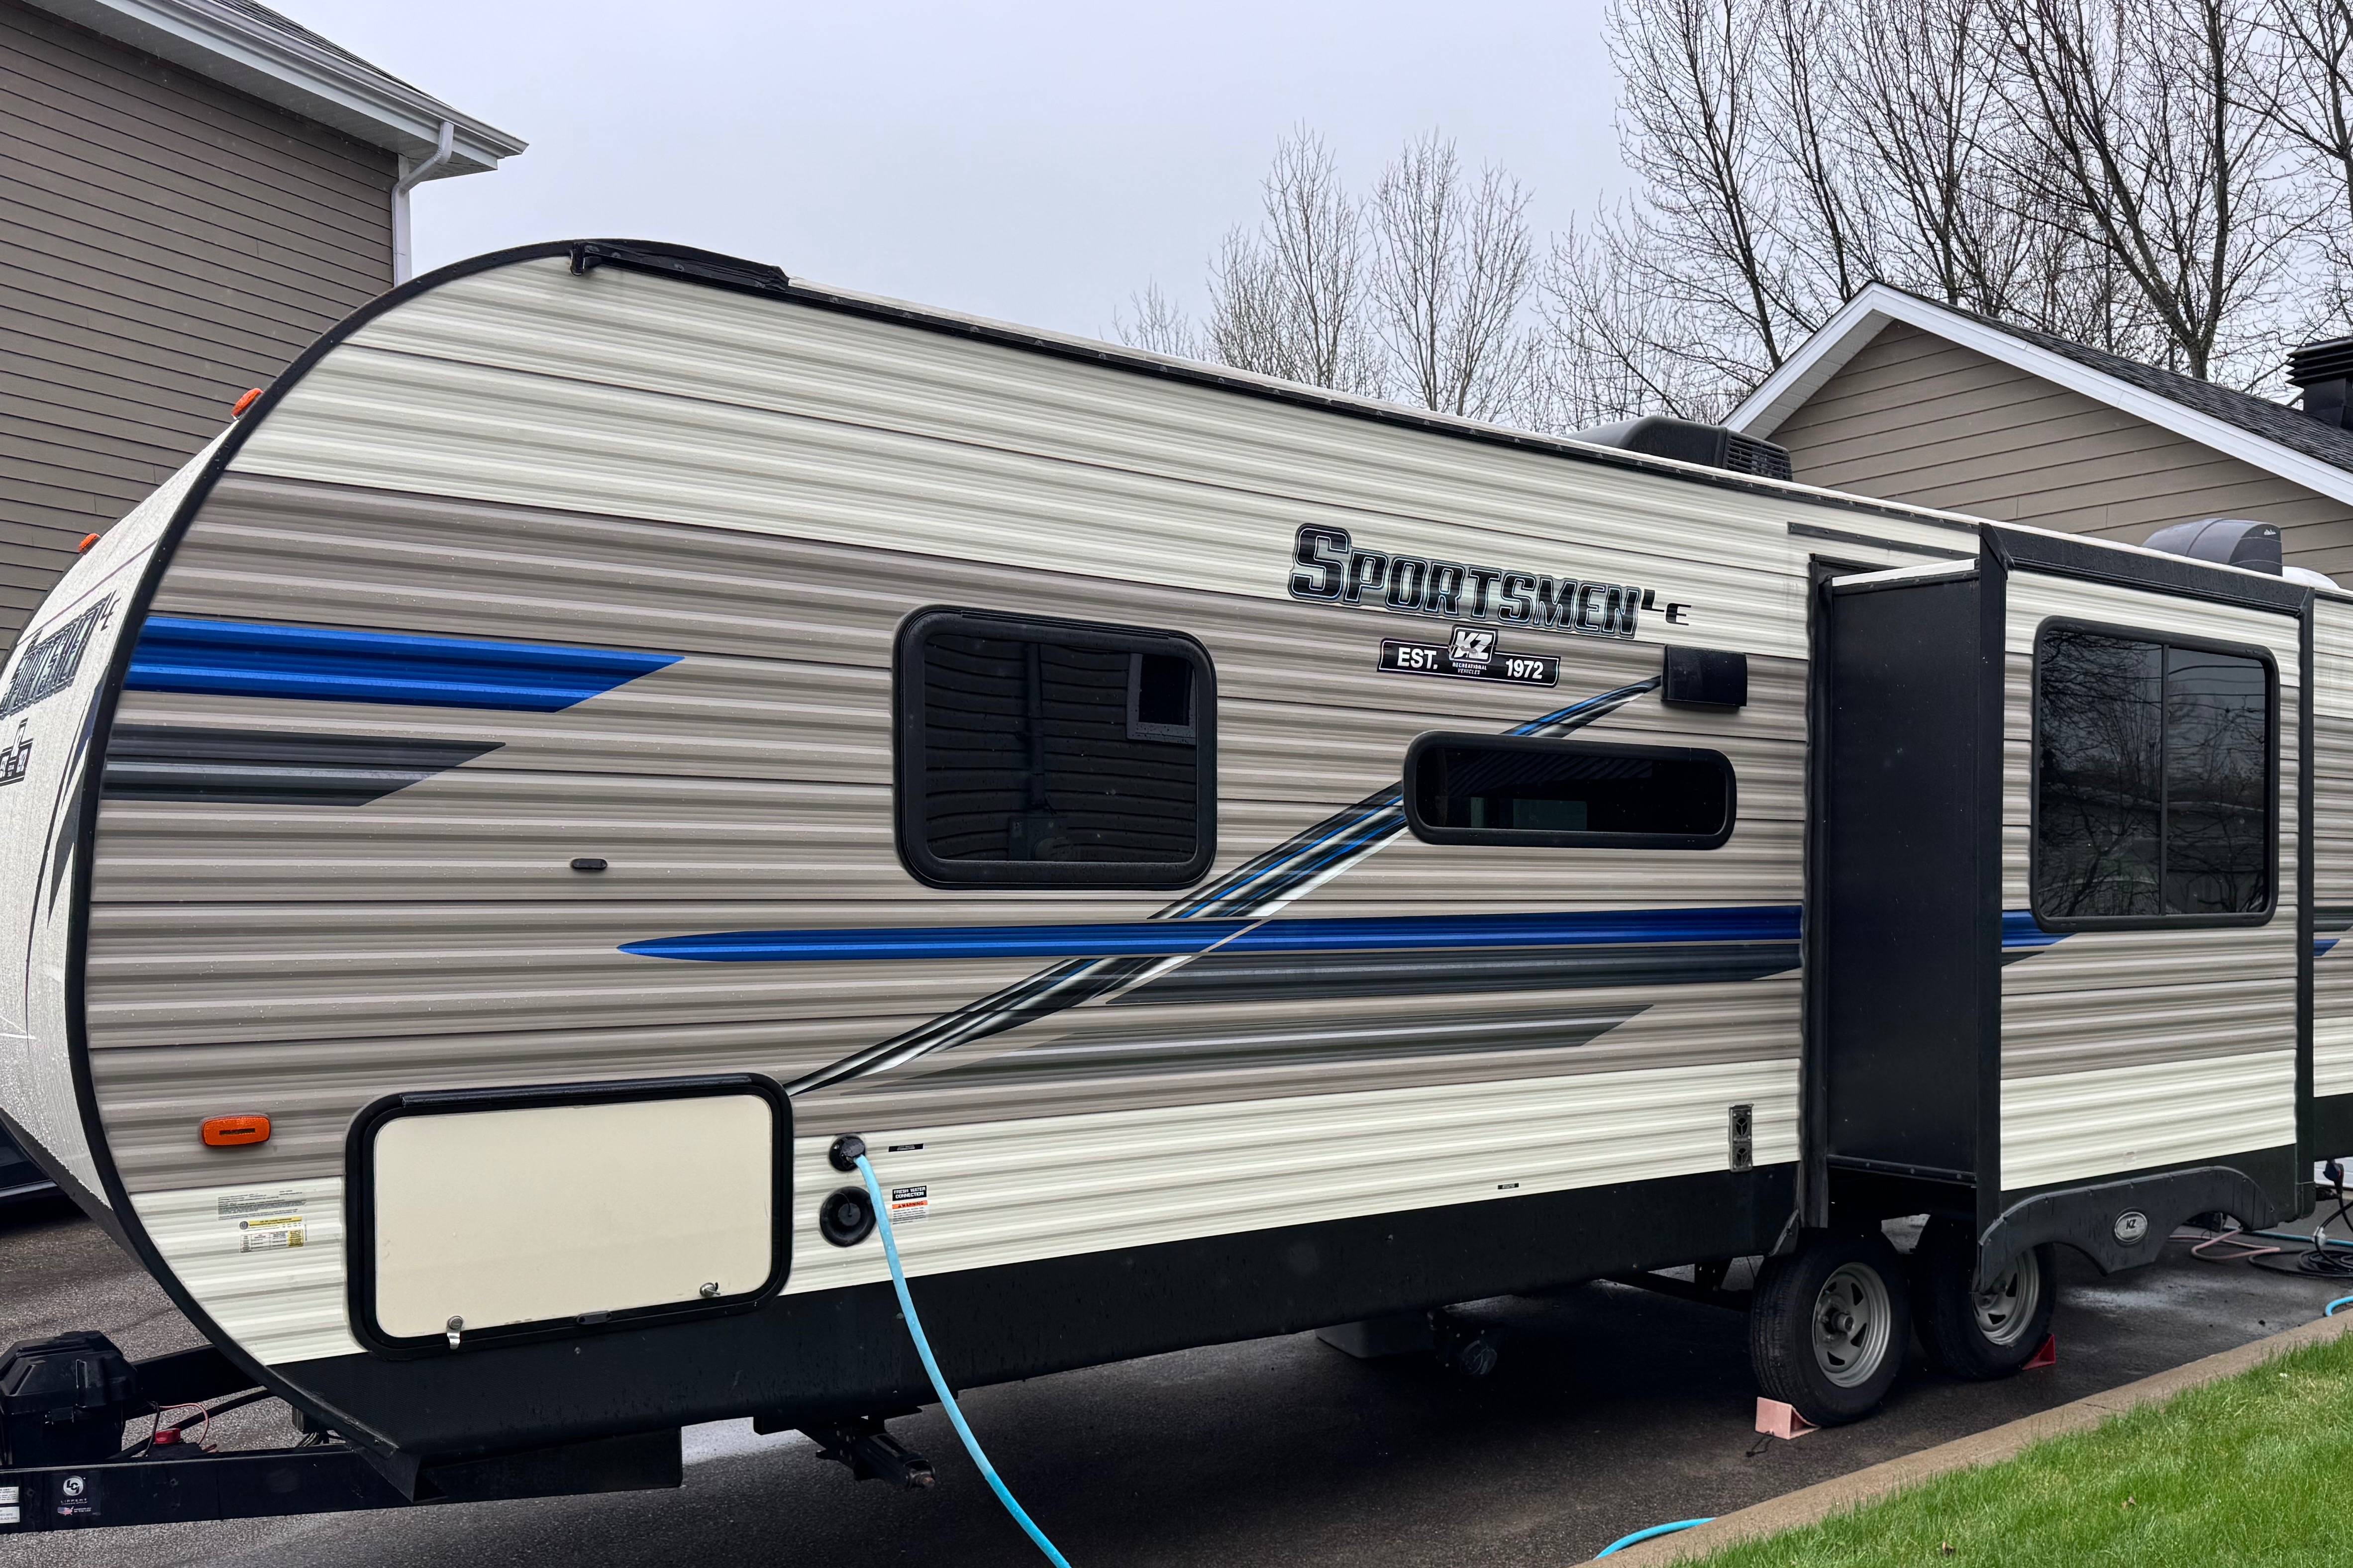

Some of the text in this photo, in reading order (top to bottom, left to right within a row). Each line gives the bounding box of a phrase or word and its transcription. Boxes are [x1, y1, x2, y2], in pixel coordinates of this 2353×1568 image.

[1289, 524, 1641, 638] SPORTSMEN
[1397, 647, 1543, 680] EST. 1972
[2126, 1219, 2136, 1230] KZ
